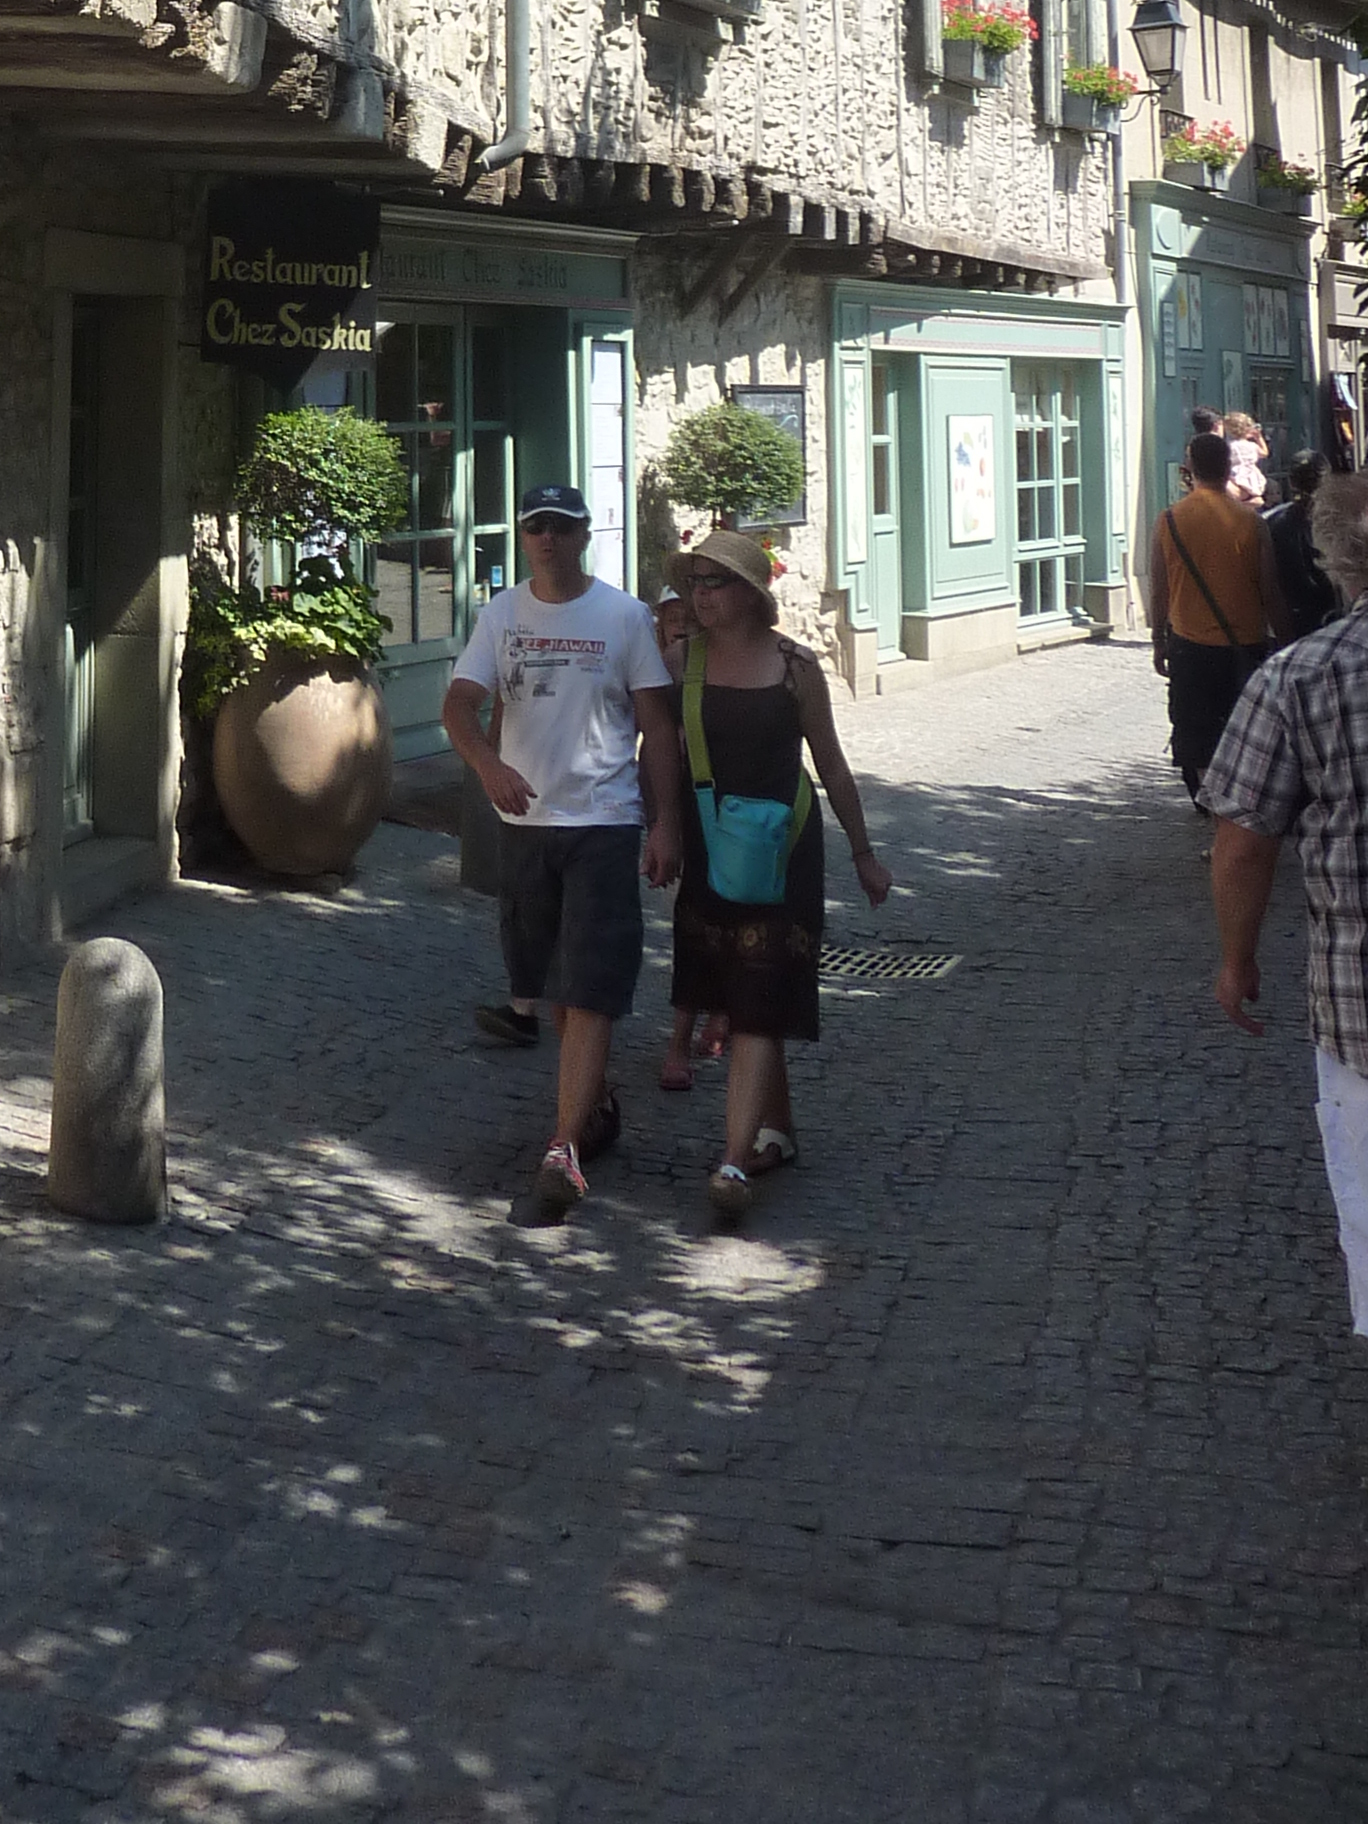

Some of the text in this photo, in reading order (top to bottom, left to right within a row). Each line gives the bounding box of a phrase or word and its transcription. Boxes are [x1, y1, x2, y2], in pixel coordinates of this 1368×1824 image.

[209, 236, 372, 290] Restaurant
[206, 297, 372, 353] Chez Saskia
